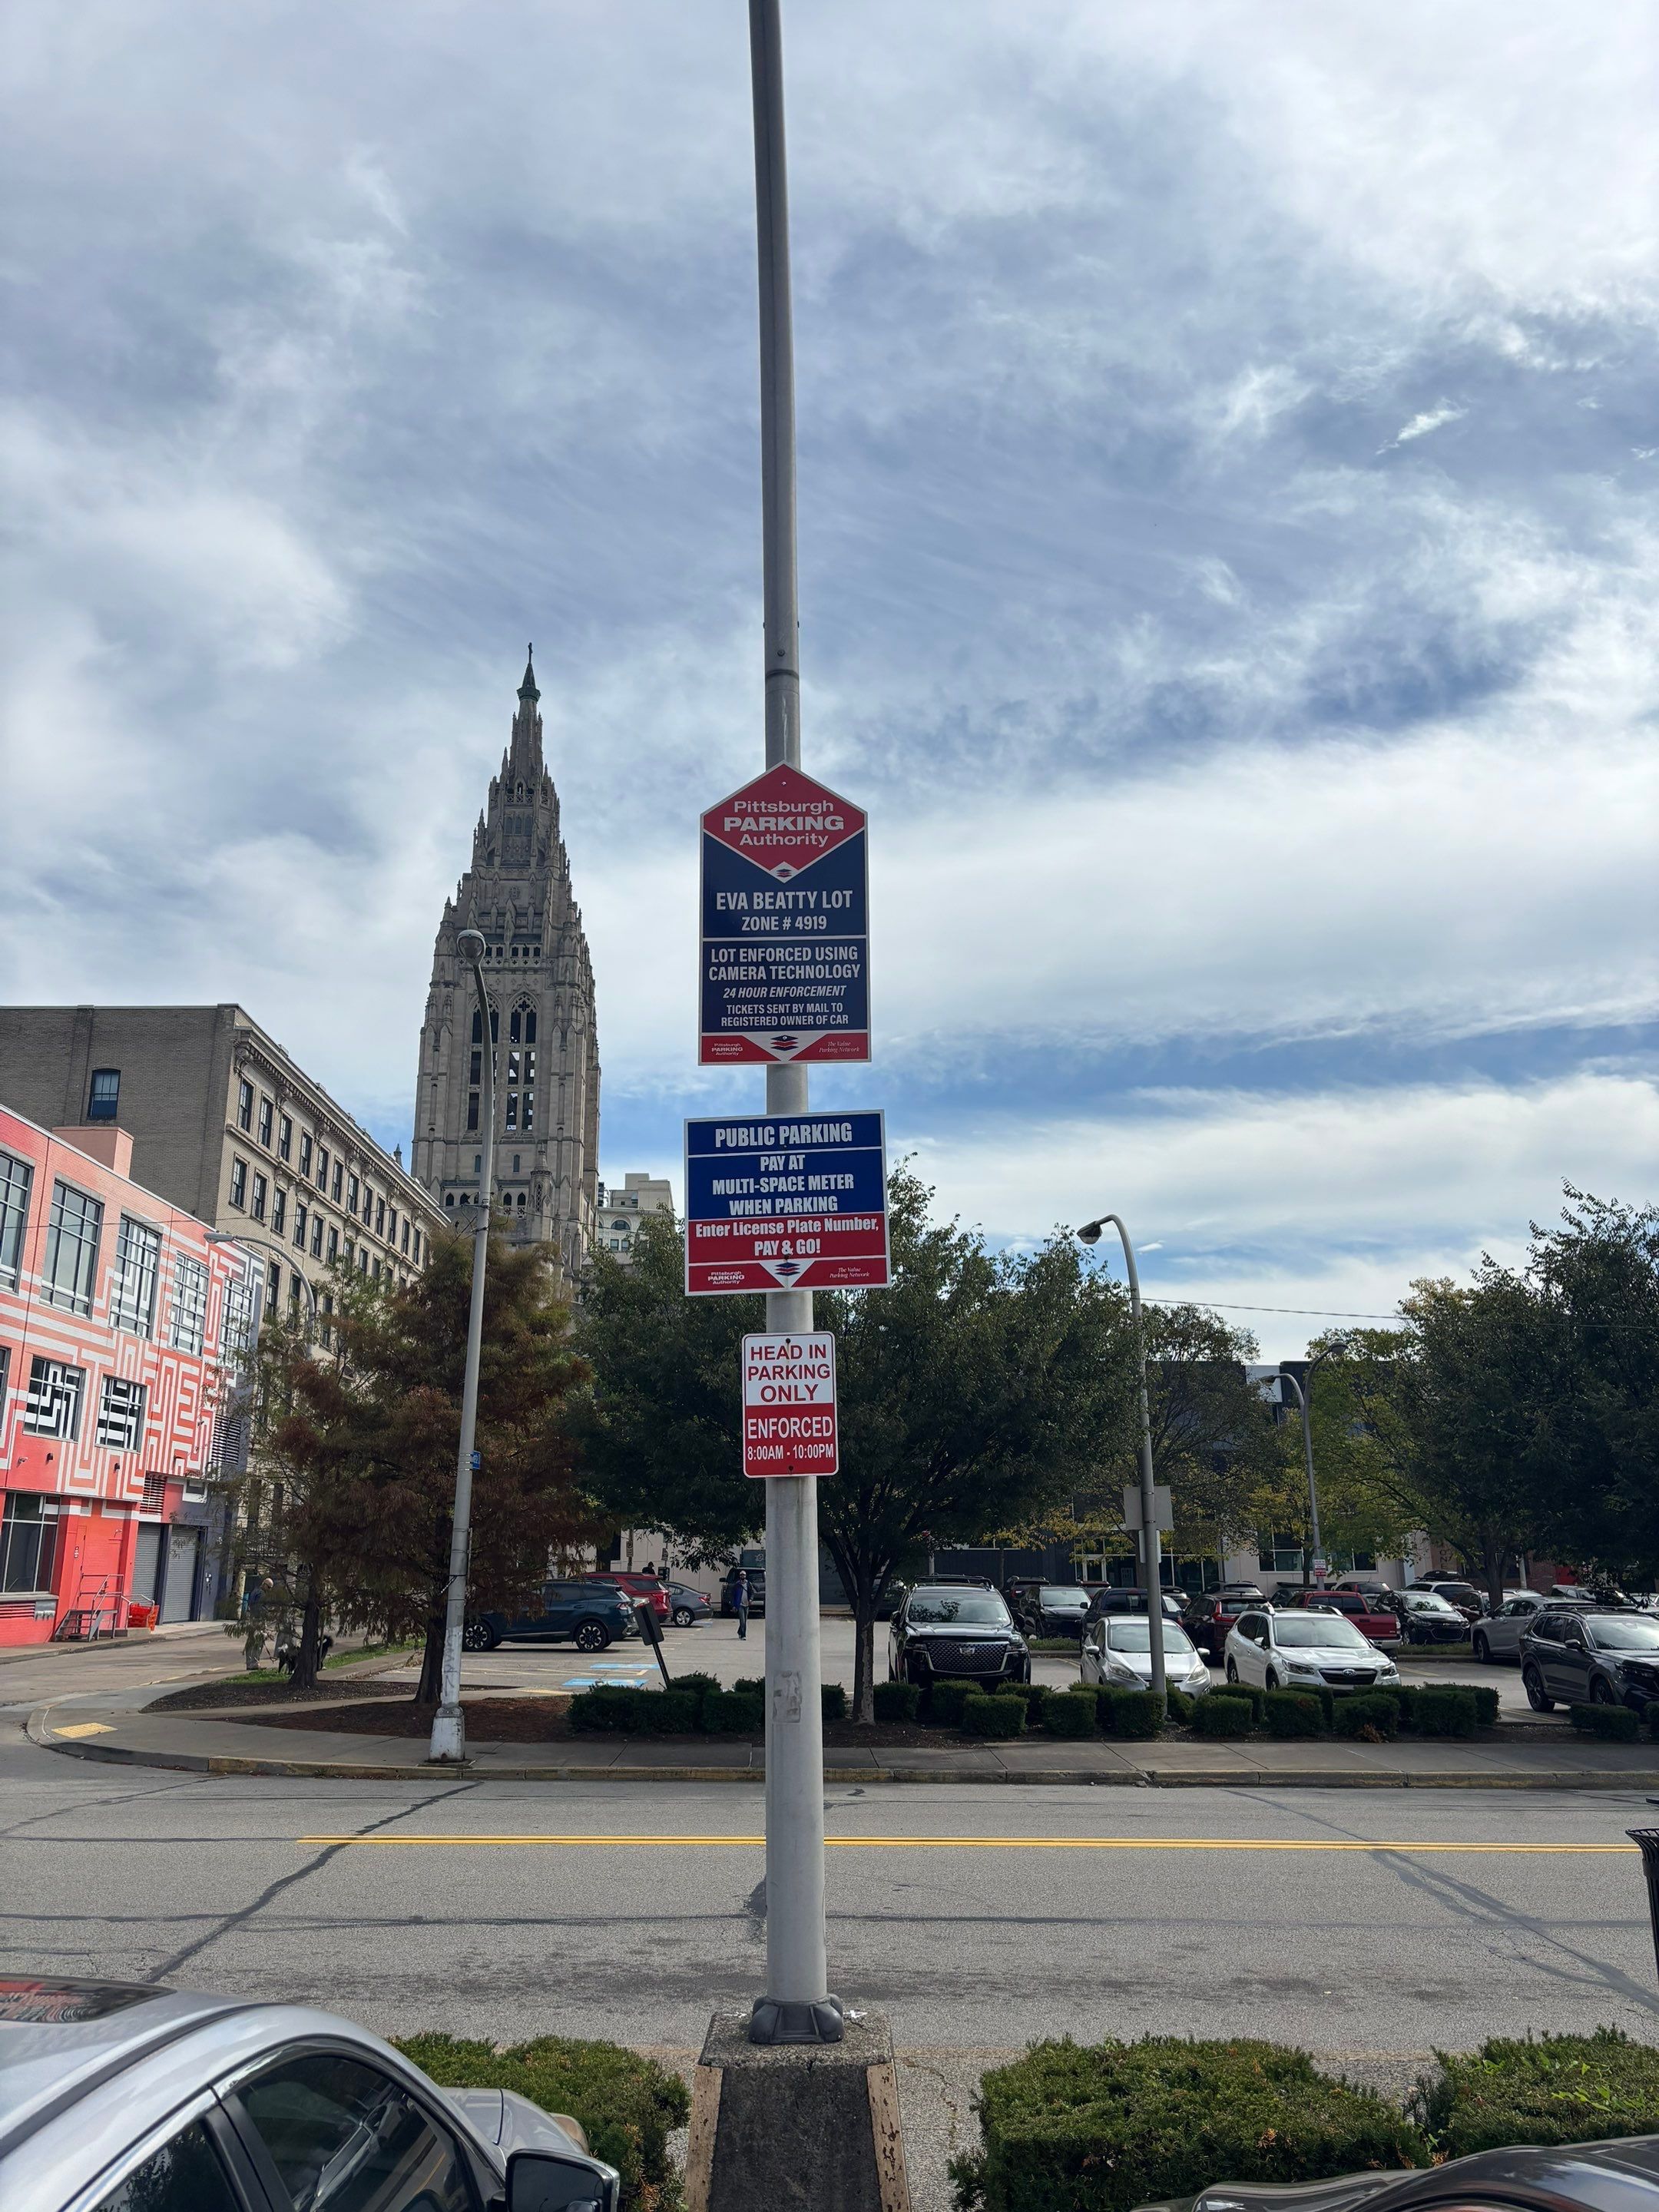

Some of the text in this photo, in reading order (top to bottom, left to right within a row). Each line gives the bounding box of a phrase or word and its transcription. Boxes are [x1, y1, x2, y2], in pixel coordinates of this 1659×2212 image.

[734, 800, 833, 815] Pittsburgh
[724, 816, 844, 831] PARKING
[740, 833, 829, 847] Authority
[716, 890, 853, 910] EVA BEATTY LOT
[741, 916, 826, 931] ZONE # 4919
[711, 945, 858, 962] LOT ENFORCED USING
[709, 964, 861, 981] CAMERA TECHNOLOGY
[723, 985, 846, 998] 24 HOUR ENFORCEMENT
[727, 1002, 843, 1015] TICKETS SENT BY MAIL TO
[721, 1015, 849, 1027] REGISTERED OWNER OF CAR
[715, 1122, 853, 1147] PUBLIC PARKING
[760, 1154, 806, 1171] PAY AT
[712, 1174, 854, 1195] MULTI-SPACE METER
[730, 1196, 838, 1216] WHEN PARKING
[696, 1217, 879, 1237] Enter License Plate Number,
[754, 1238, 821, 1257] PAY & GO!
[751, 1344, 826, 1361] HEAD IN
[748, 1363, 830, 1381] PARKING
[760, 1384, 819, 1402] ONLY
[747, 1416, 833, 1439] ENFORCED
[747, 1445, 783, 1461] 8:00AM
[793, 1443, 834, 1459] 10:00PM
